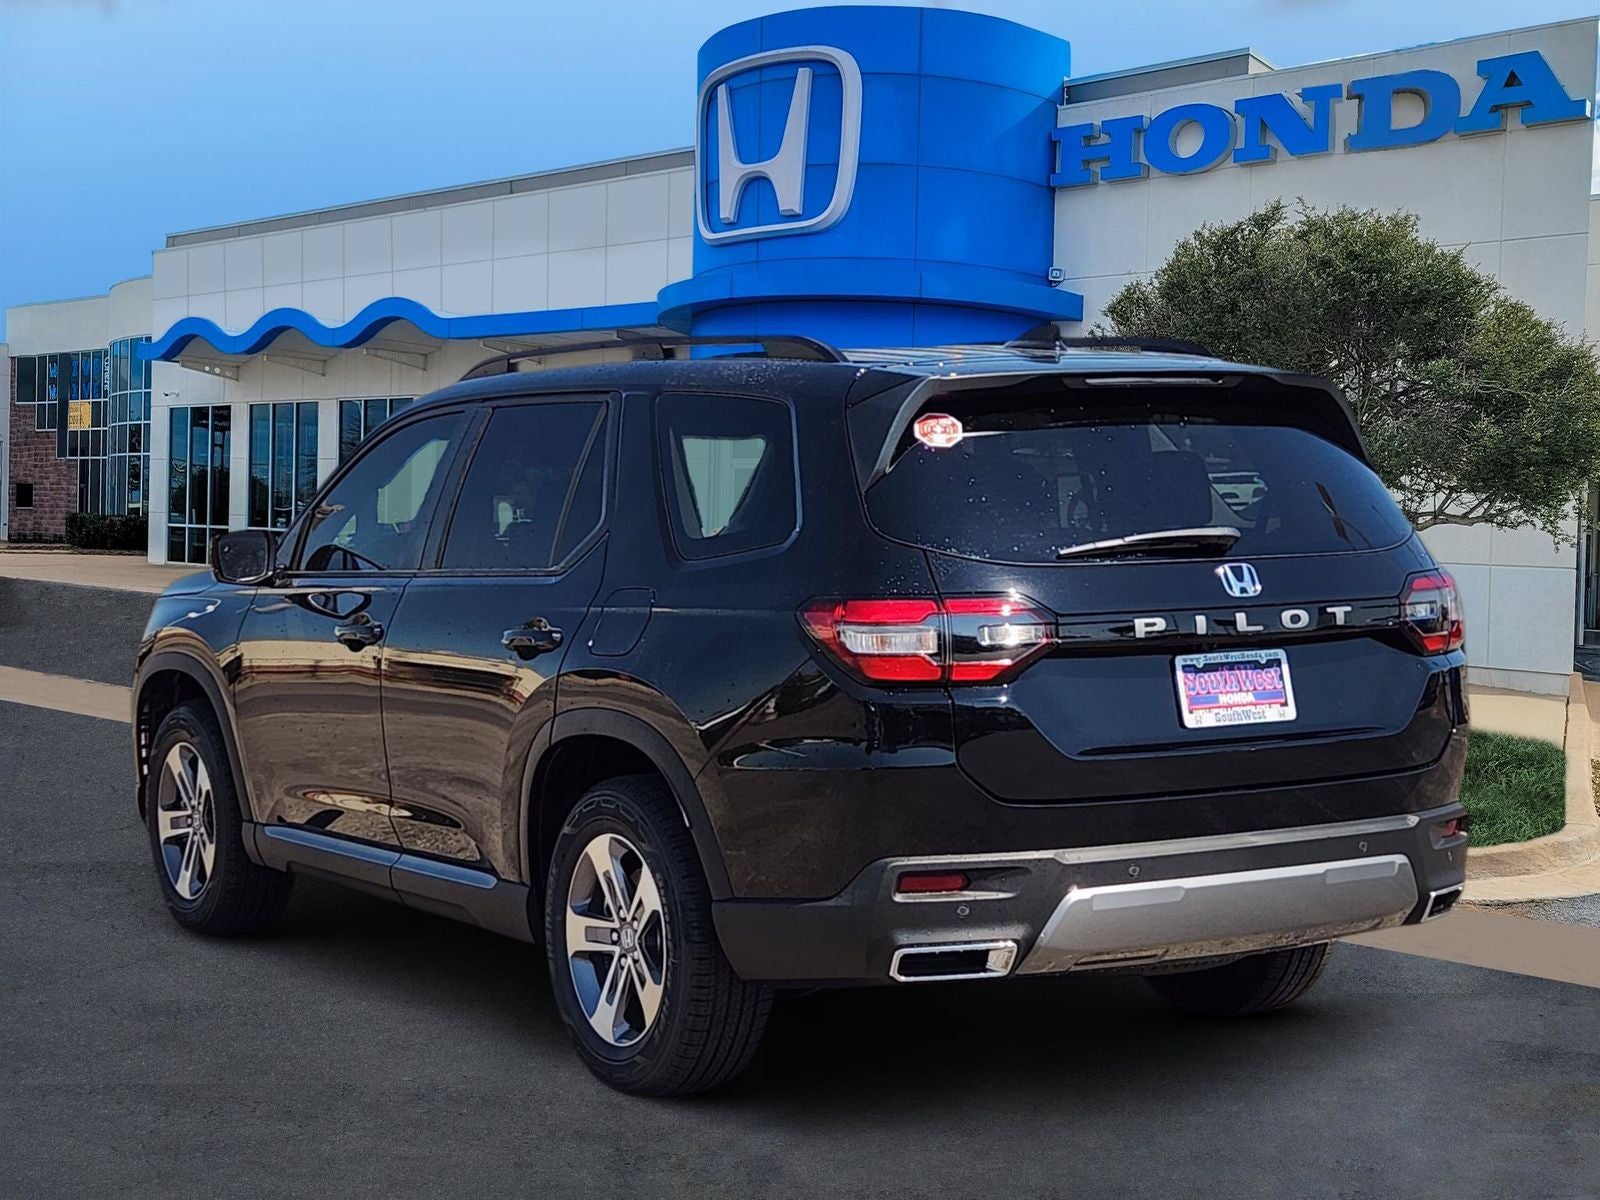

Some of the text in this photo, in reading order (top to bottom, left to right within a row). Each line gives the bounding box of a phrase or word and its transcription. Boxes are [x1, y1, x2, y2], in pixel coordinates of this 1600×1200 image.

[1051, 50, 1592, 188] HONDA
[1133, 605, 1353, 639] PILOT
[1219, 691, 1256, 705] HONDA
[1214, 710, 1268, 724] SouthWest
